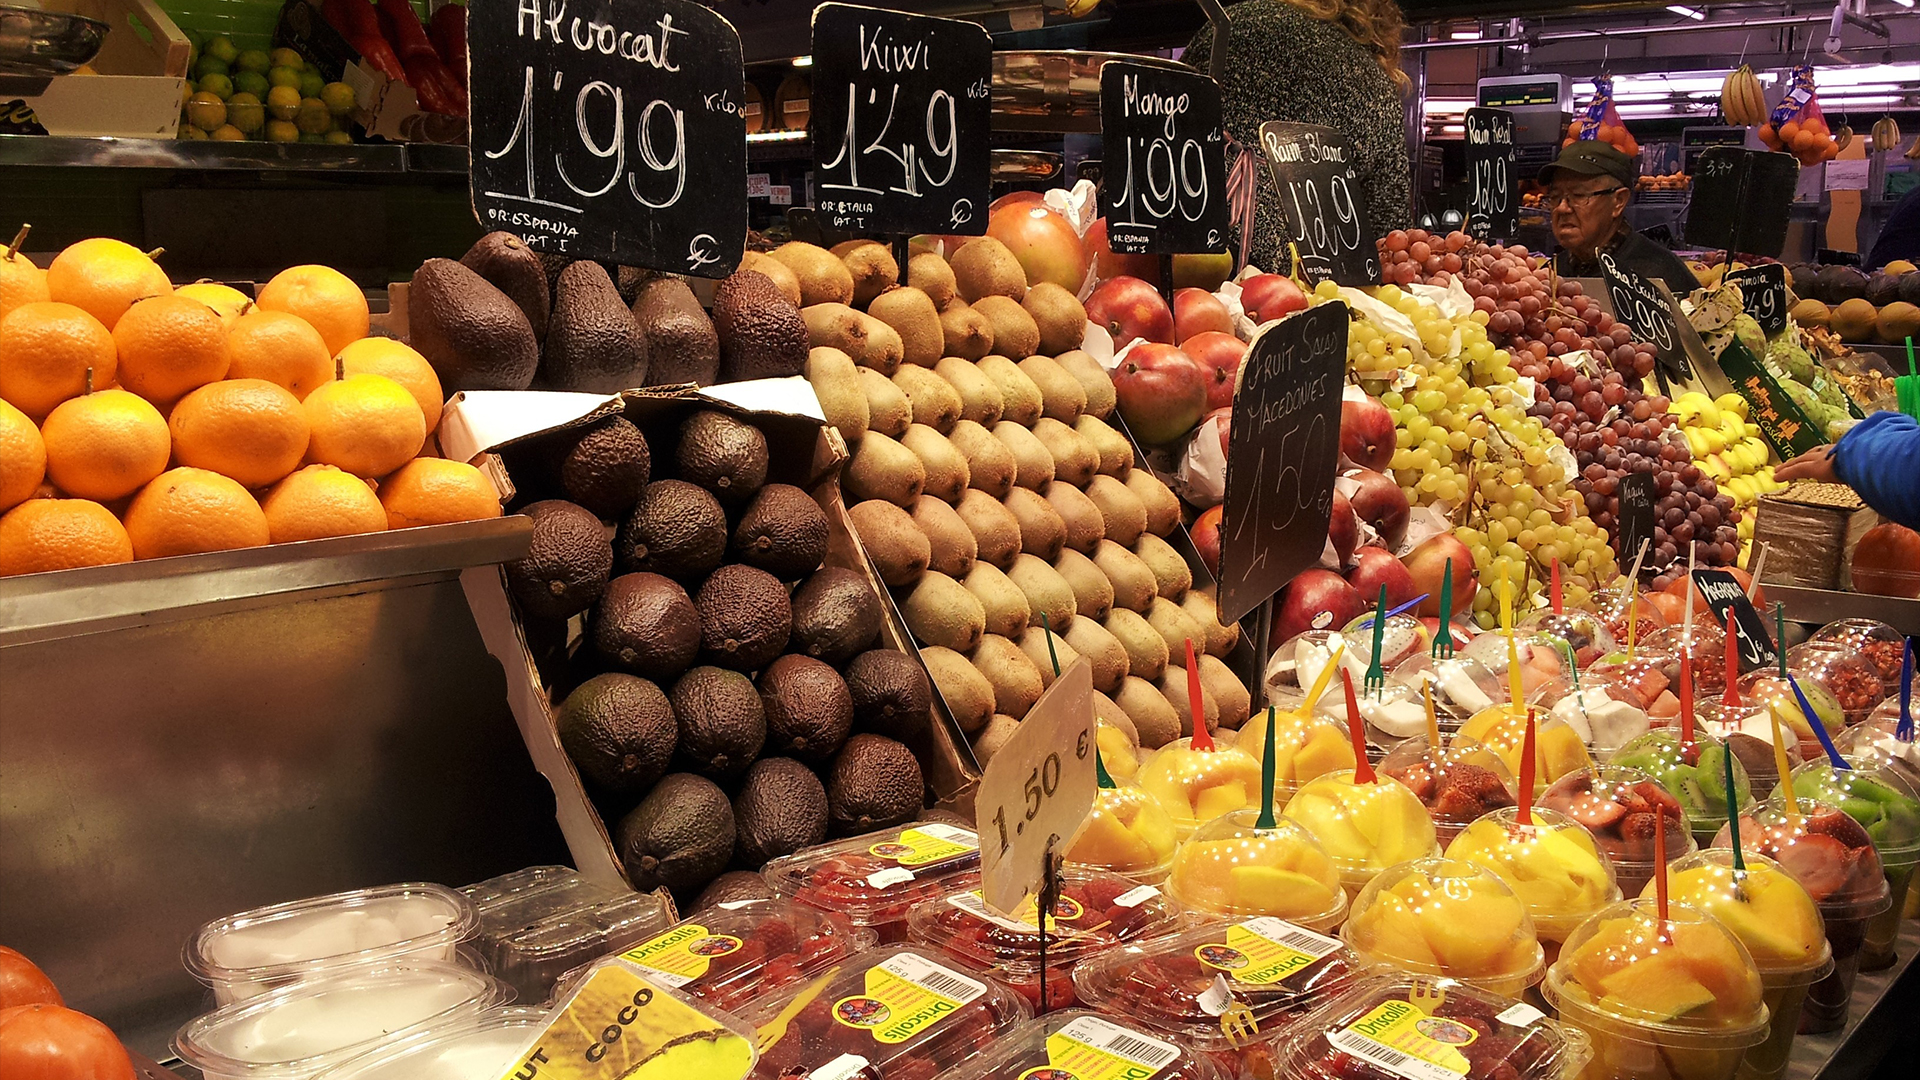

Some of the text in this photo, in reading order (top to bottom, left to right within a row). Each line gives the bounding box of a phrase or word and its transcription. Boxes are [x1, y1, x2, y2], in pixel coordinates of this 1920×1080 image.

[859, 23, 930, 73] Kiwi
[1123, 73, 1190, 141] Mango
[1304, 131, 1348, 164] Blanc
[1600, 253, 1633, 290] Pera
[1247, 339, 1295, 391] FRUIT
[1760, 420, 1782, 446] Costa
[992, 728, 1090, 860] 1.50 €
[626, 927, 699, 960] Driscoll's
[886, 963, 902, 974] 125
[1241, 955, 1311, 984] Driscoll's
[509, 987, 655, 1080] UT COCO
[884, 1001, 956, 1040] Driscoll's
[1067, 1029, 1084, 1040] 125
[1354, 1001, 1411, 1036] Driscoll's
